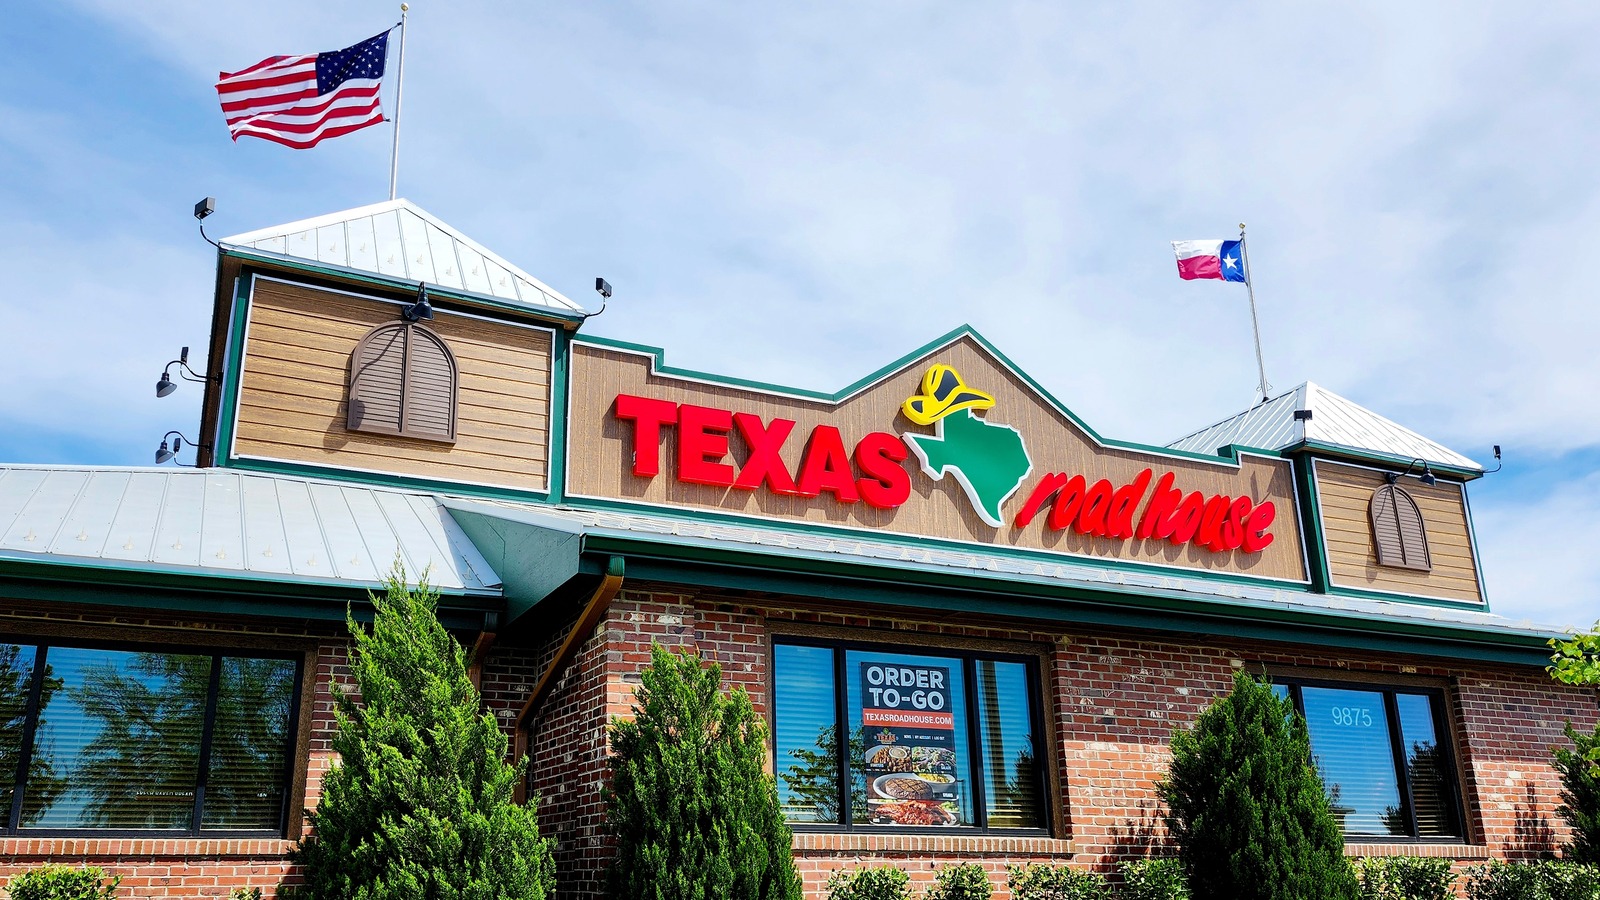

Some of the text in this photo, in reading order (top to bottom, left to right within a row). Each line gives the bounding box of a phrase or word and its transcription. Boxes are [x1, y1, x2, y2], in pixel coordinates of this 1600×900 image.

[614, 393, 1276, 554] TEXAS roadhouse
[866, 666, 944, 689] ORDER
[868, 687, 945, 711] TO-GO
[865, 712, 953, 725] TEXASROADHOUSE.COM
[1331, 706, 1372, 727] 9875
